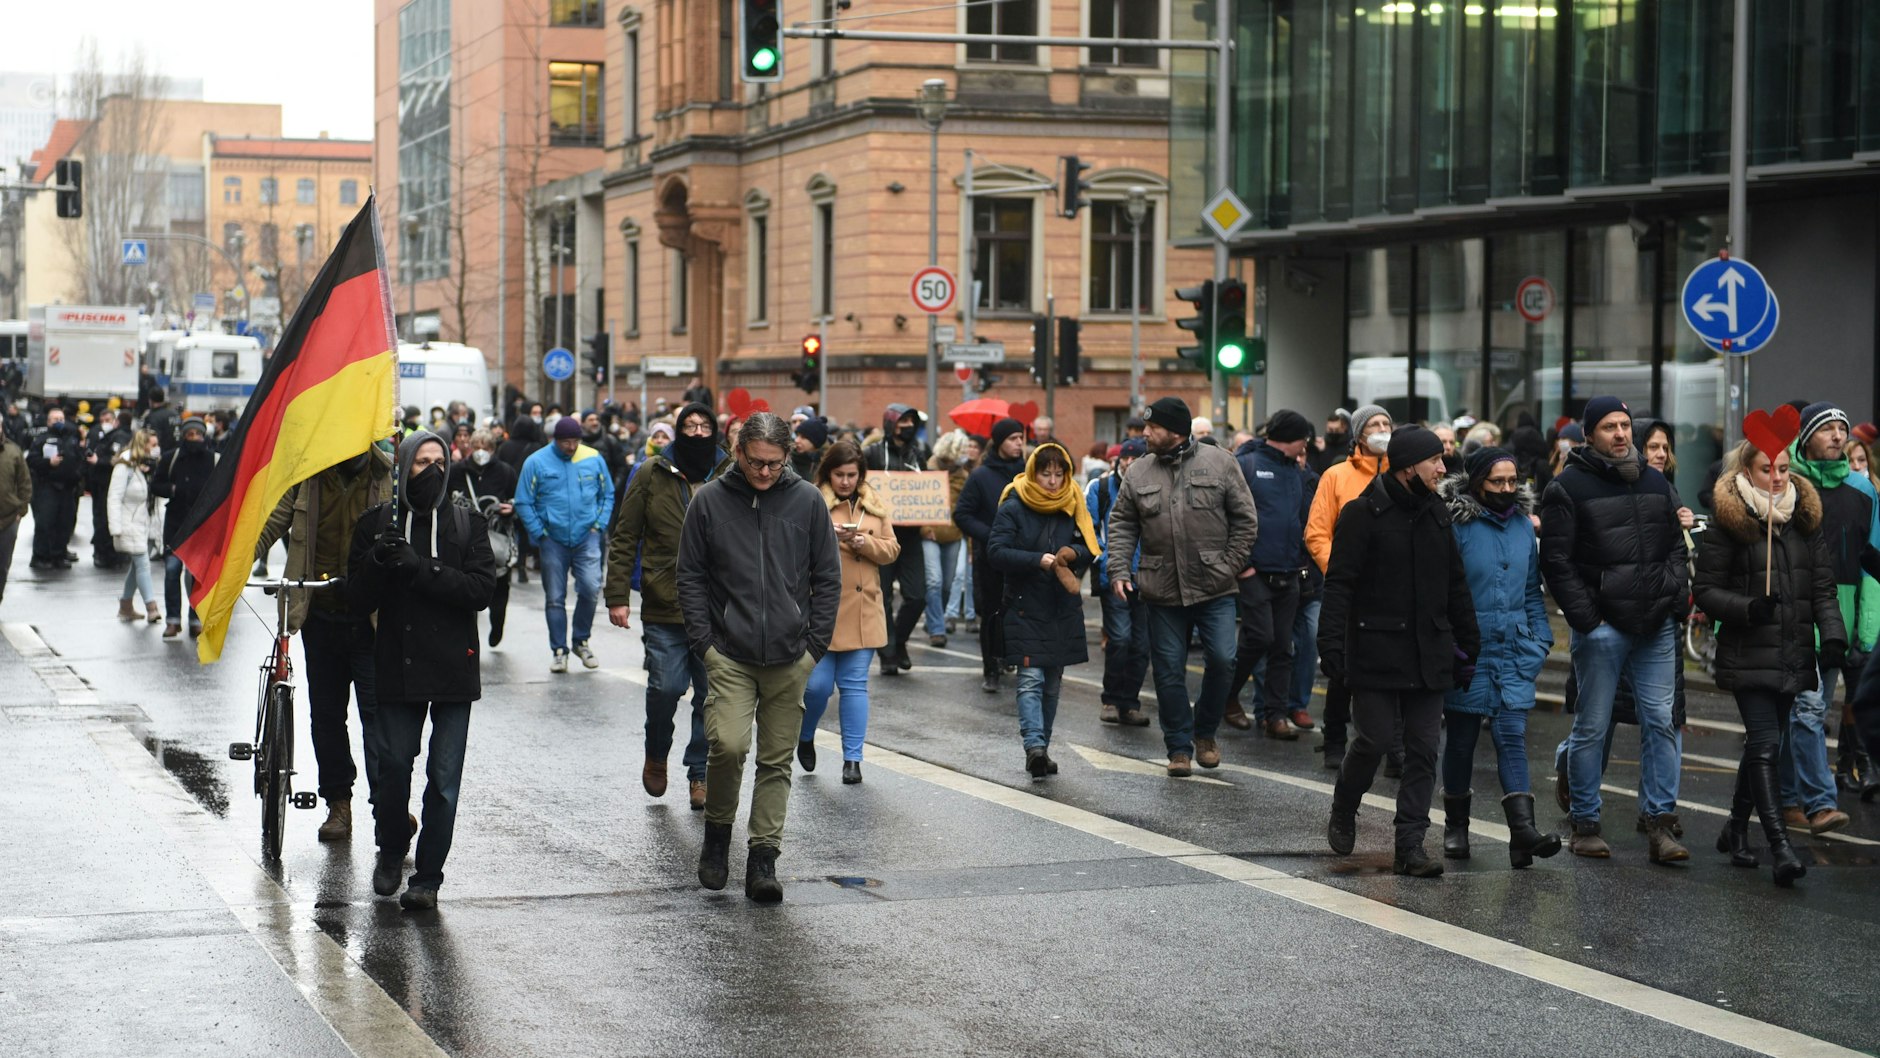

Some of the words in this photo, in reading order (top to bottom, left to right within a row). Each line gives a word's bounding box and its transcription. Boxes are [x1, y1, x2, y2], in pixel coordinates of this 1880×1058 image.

[922, 279, 947, 300] 50
[64, 312, 127, 323] PLISCHKA
[400, 364, 426, 376] IZEI
[889, 479, 941, 491] GESUND
[891, 494, 944, 506] GESELLIG
[892, 508, 950, 521] GLÜCKLICH
